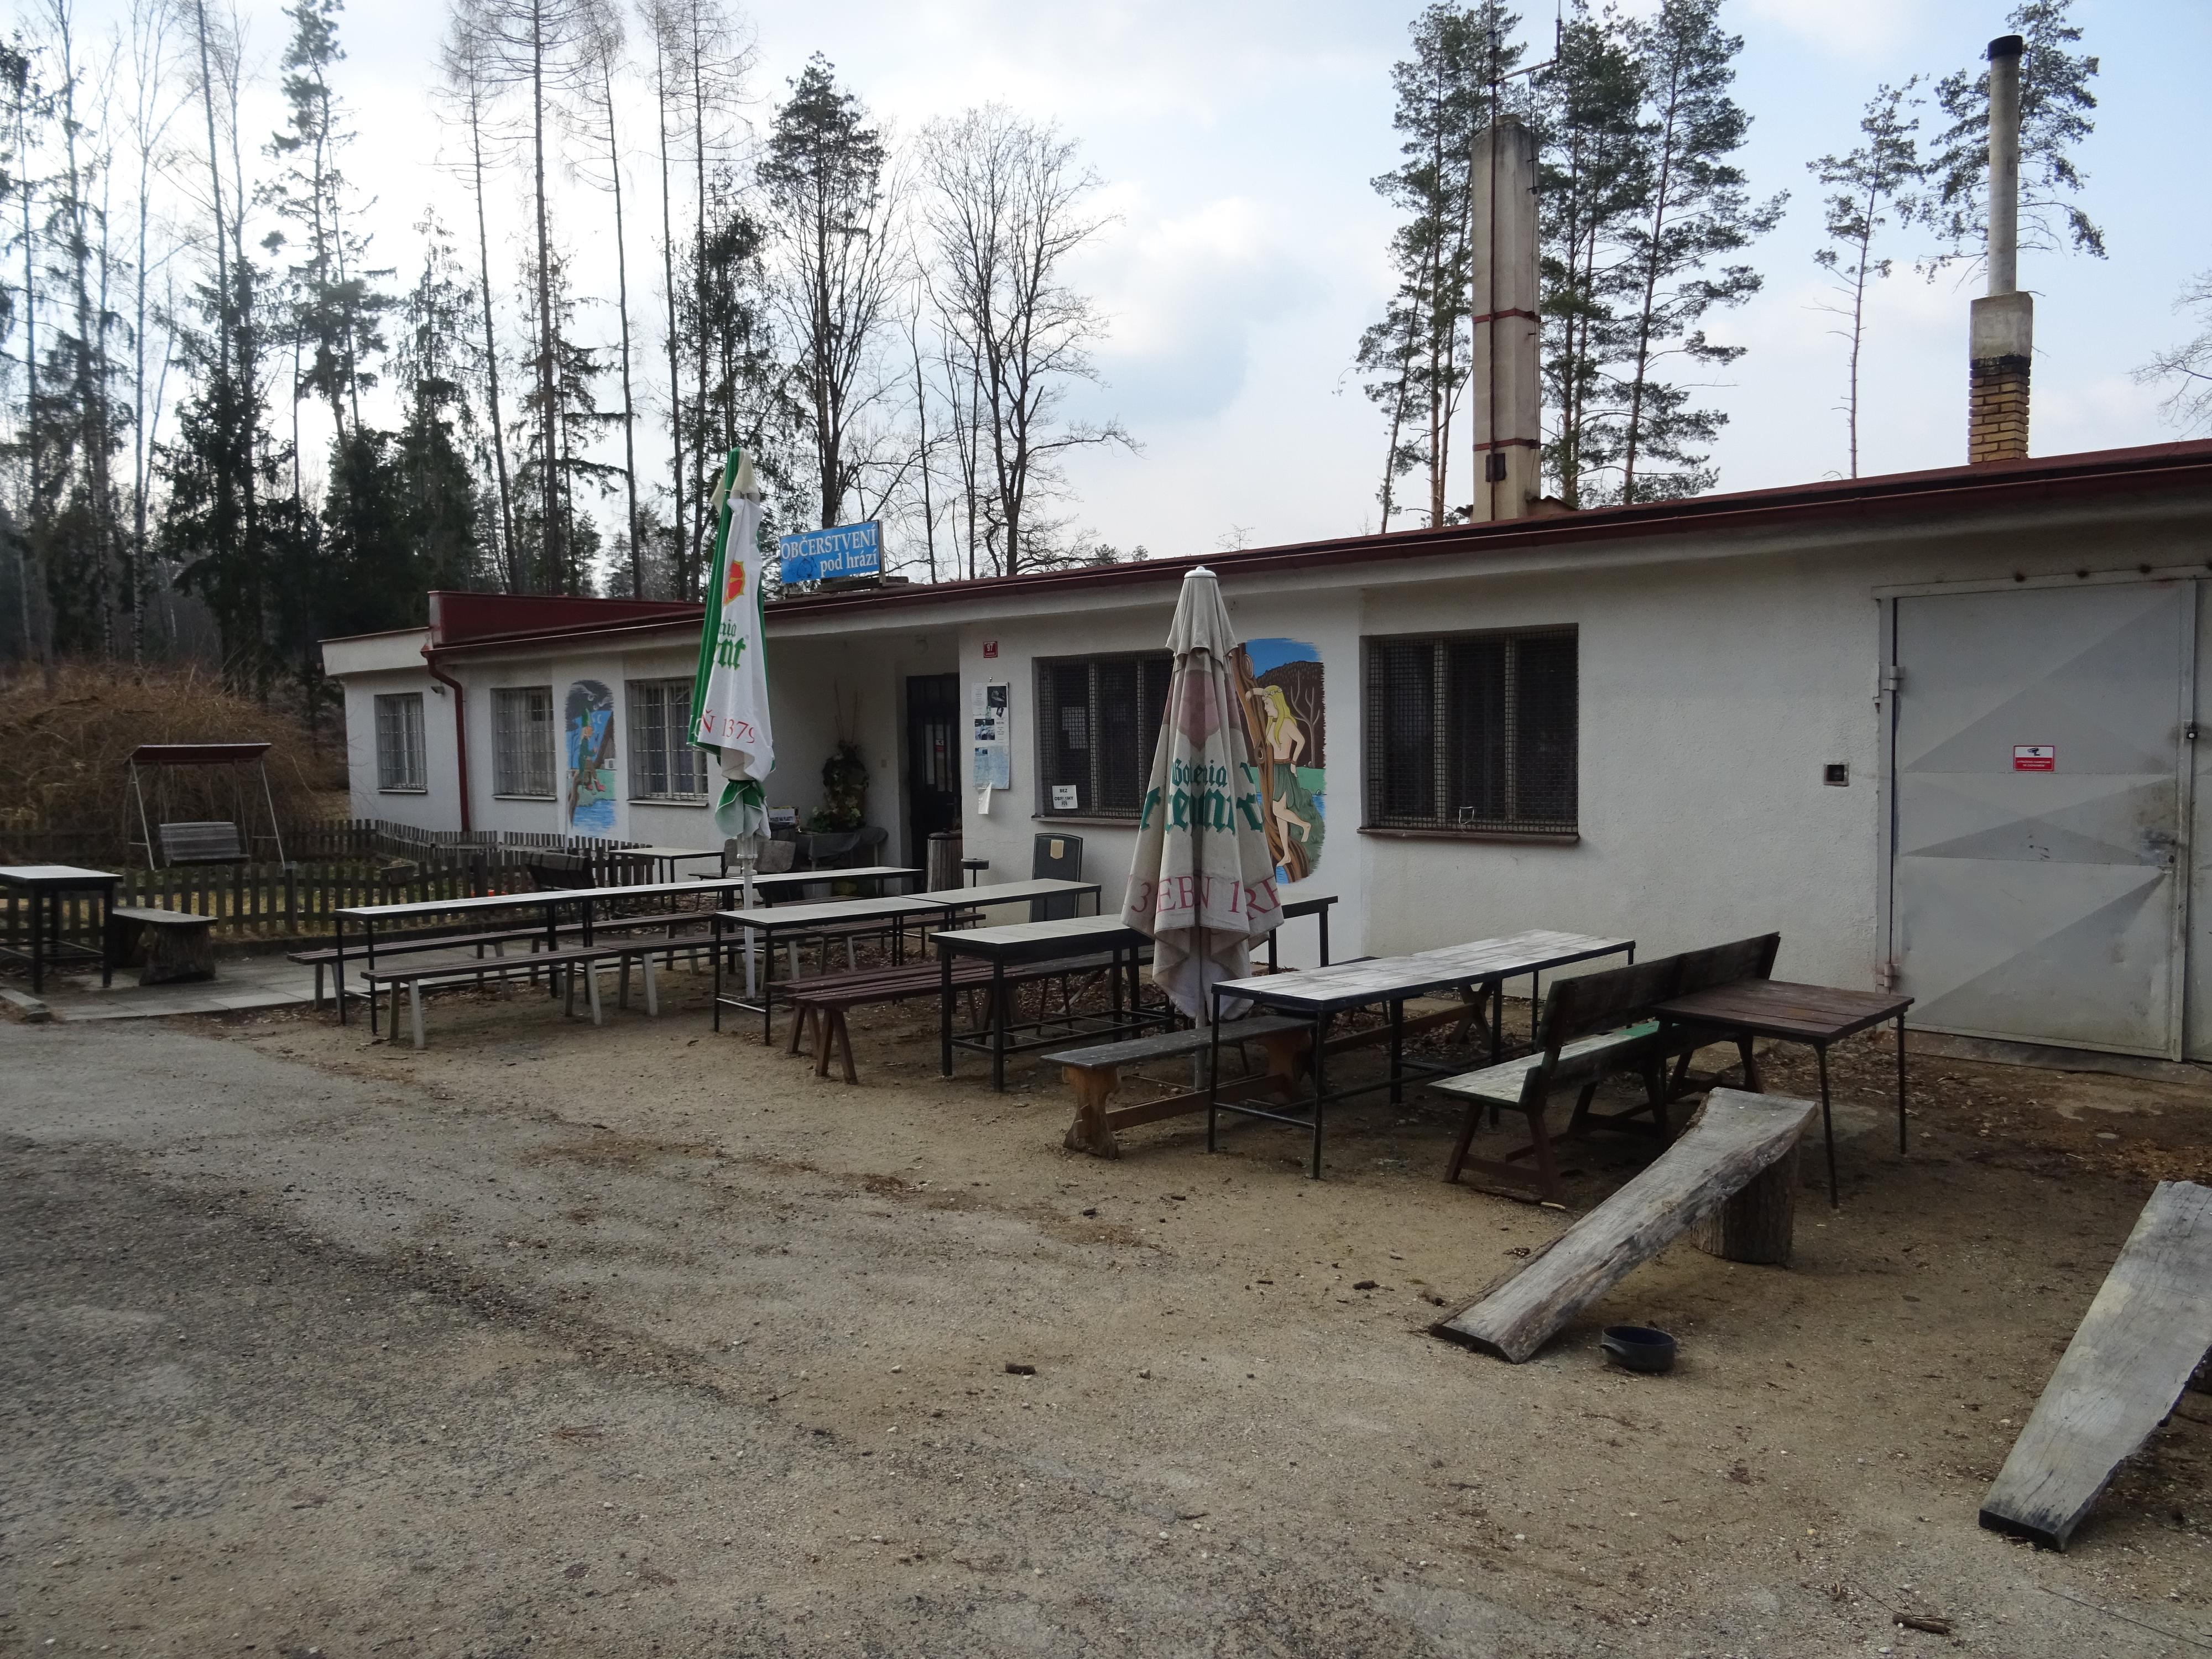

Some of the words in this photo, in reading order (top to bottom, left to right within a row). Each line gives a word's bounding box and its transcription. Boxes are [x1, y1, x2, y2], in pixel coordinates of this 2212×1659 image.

[781, 524, 877, 560] OBČERSTVENÍ
[820, 552, 843, 578] pod
[846, 549, 878, 569] hrází
